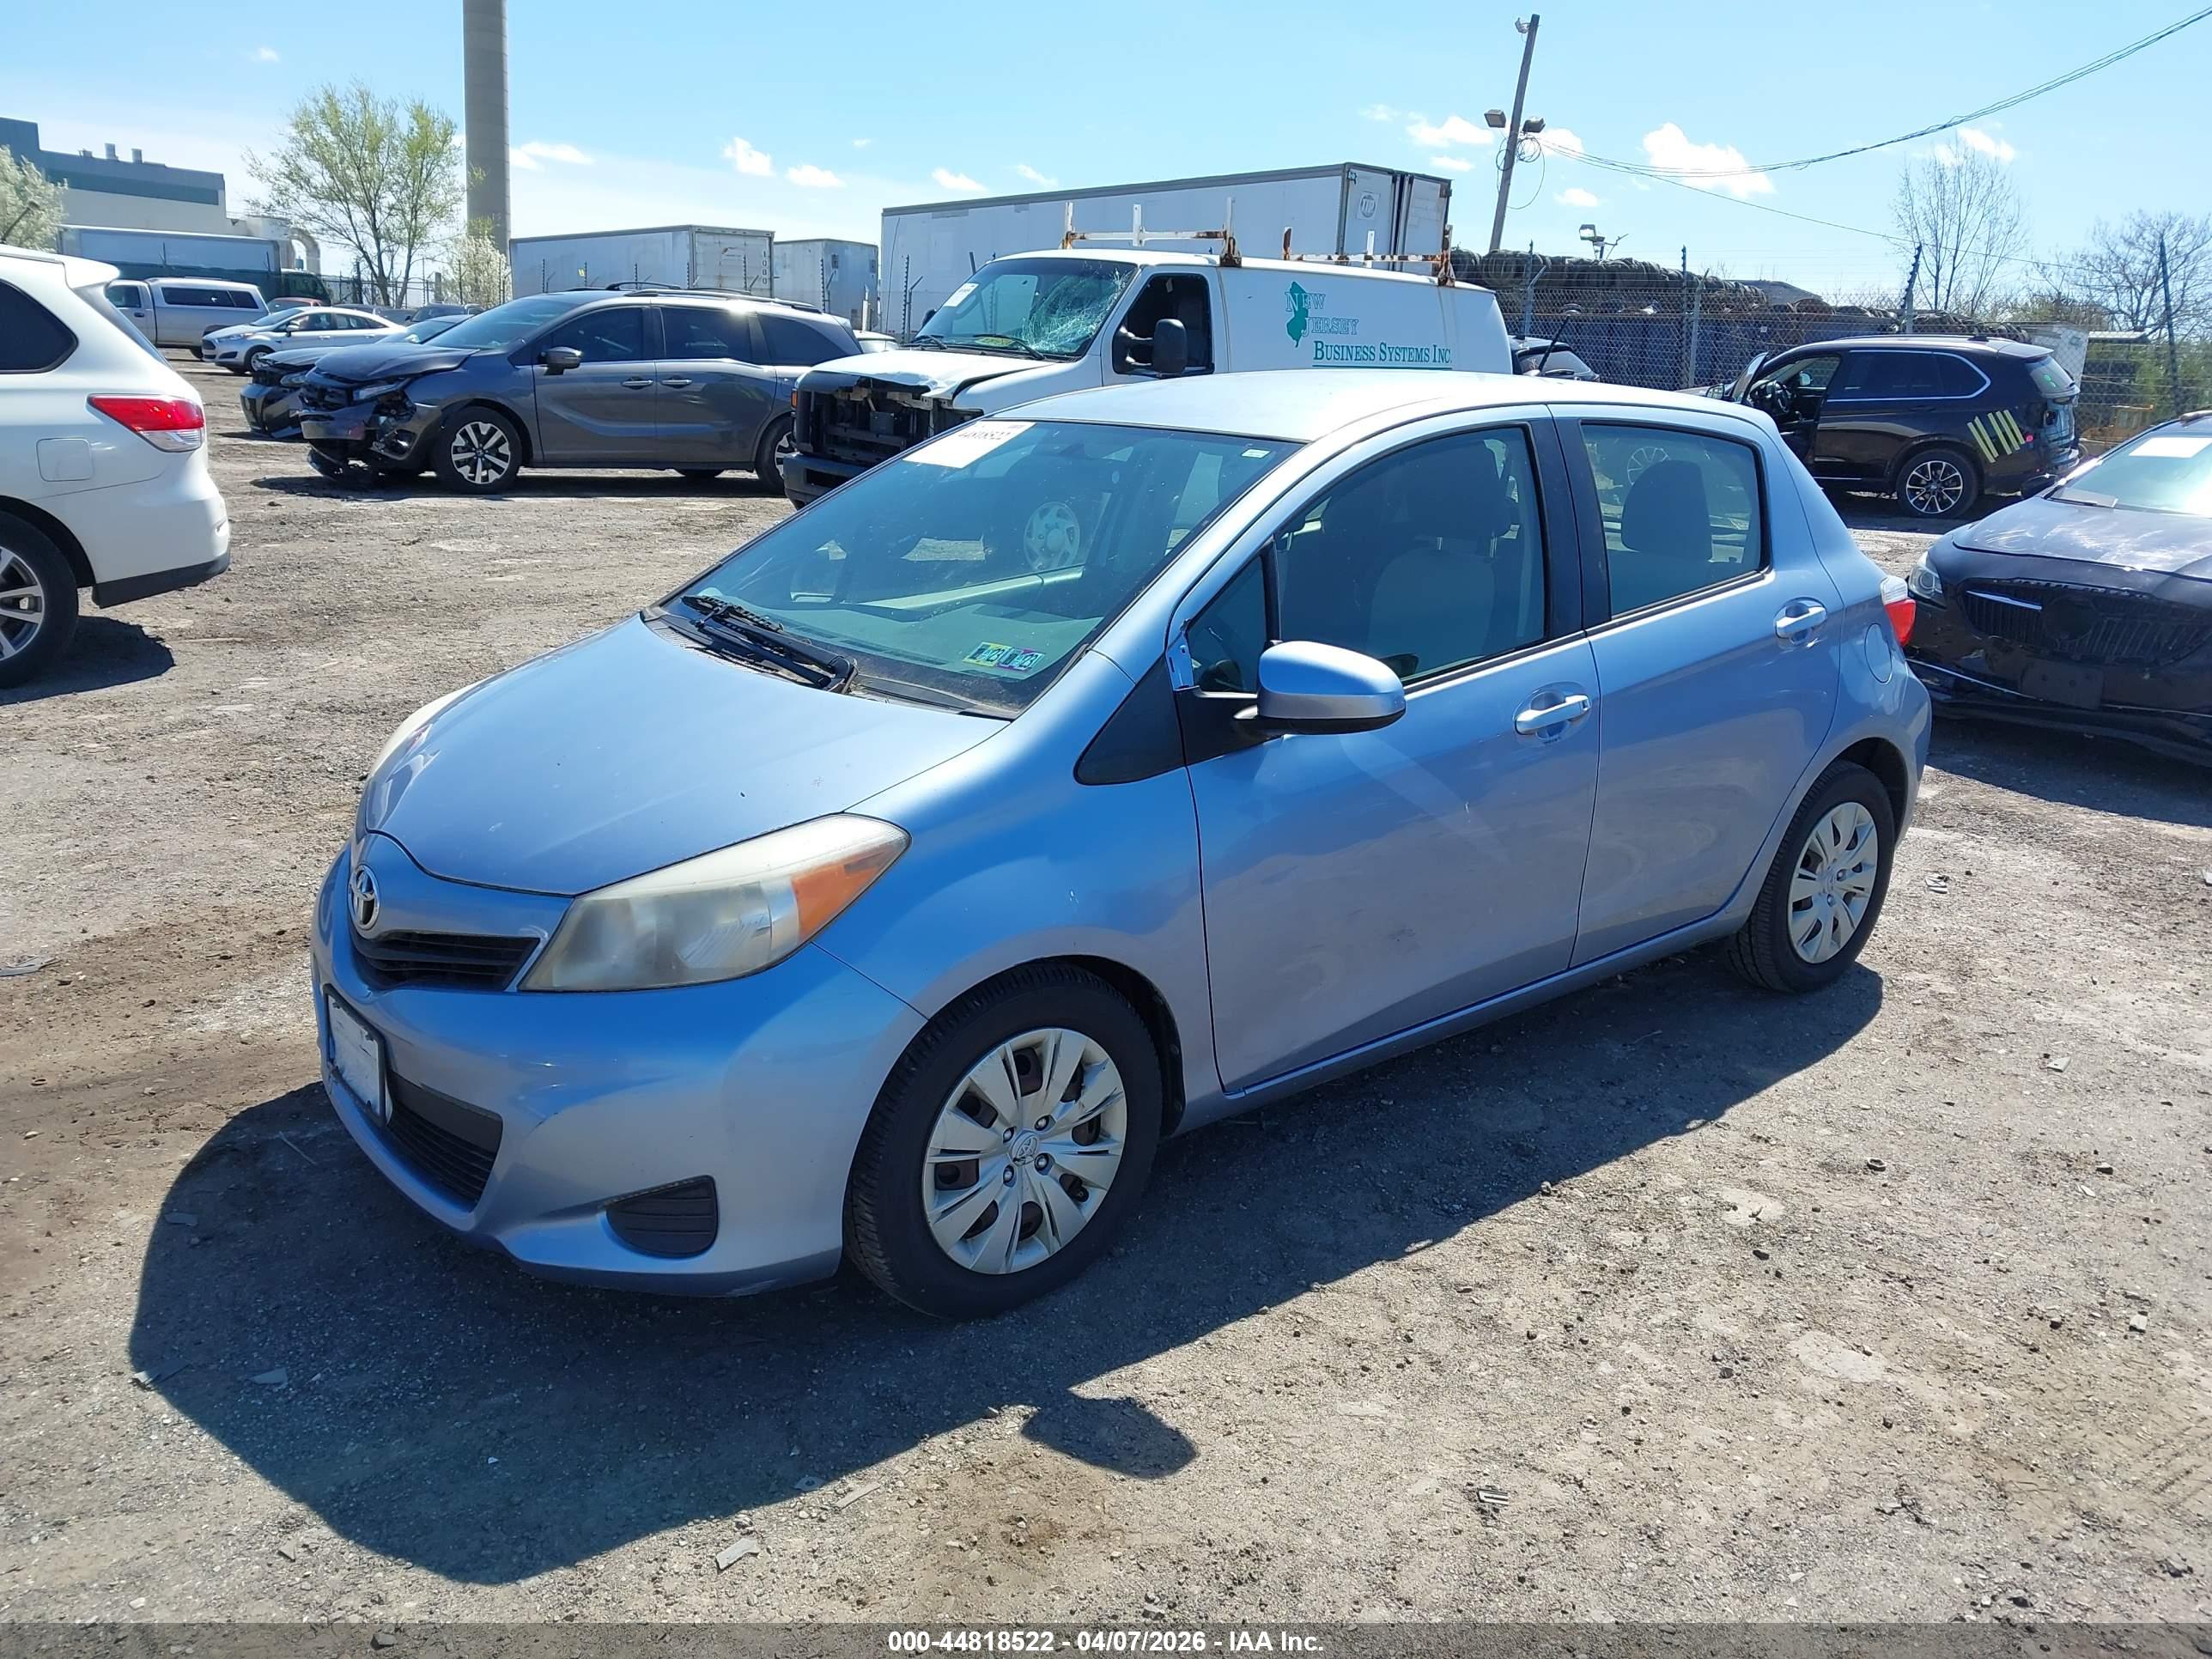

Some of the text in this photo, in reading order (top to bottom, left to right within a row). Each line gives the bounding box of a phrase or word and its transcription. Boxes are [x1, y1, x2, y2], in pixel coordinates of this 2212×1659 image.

[1285, 292, 1326, 312] NEW
[1300, 317, 1359, 337] JERSEY
[1313, 340, 1453, 364] BUSINESS SYSTEMS INC.
